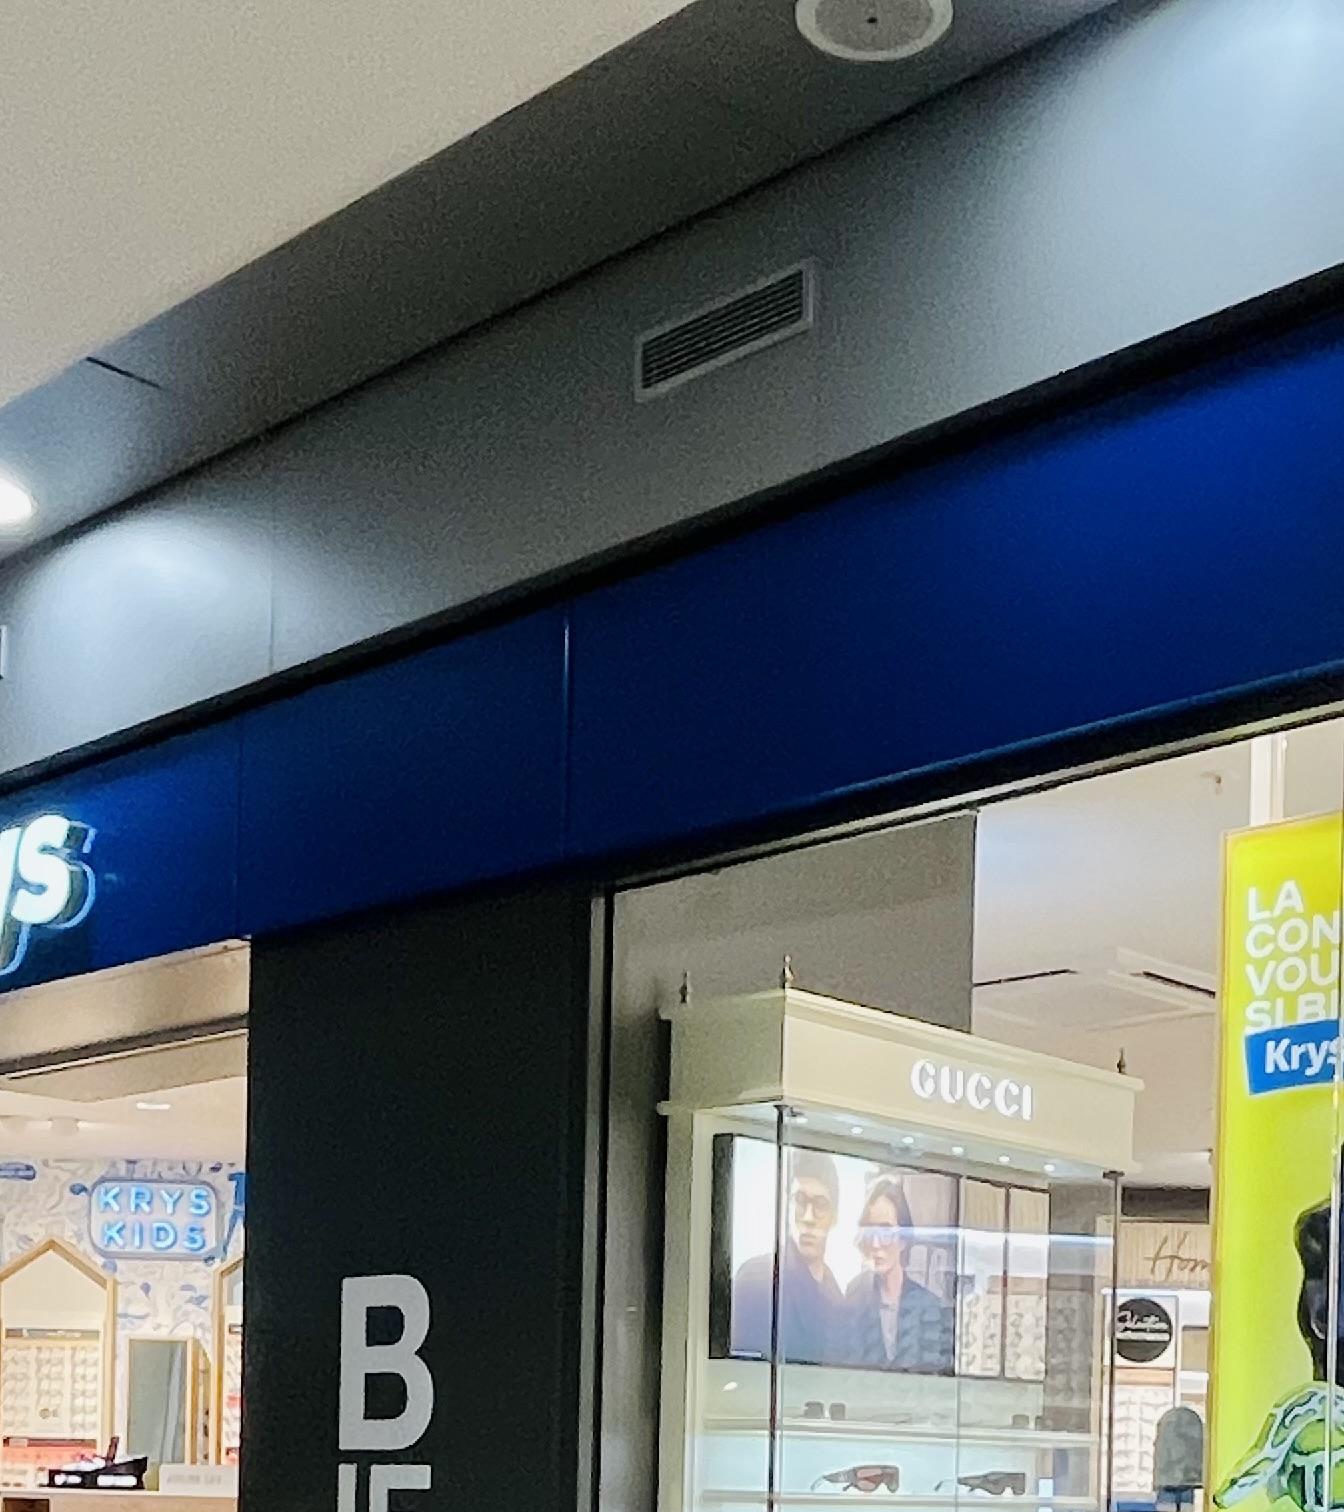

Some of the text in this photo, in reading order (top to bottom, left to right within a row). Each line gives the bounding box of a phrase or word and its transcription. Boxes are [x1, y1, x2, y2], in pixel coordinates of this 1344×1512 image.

[1247, 879, 1305, 922] LA
[1245, 998, 1286, 1036] SI
[910, 1058, 1033, 1122] GUCCI
[99, 1185, 212, 1217] KRYS
[102, 1221, 208, 1251] KIDS
